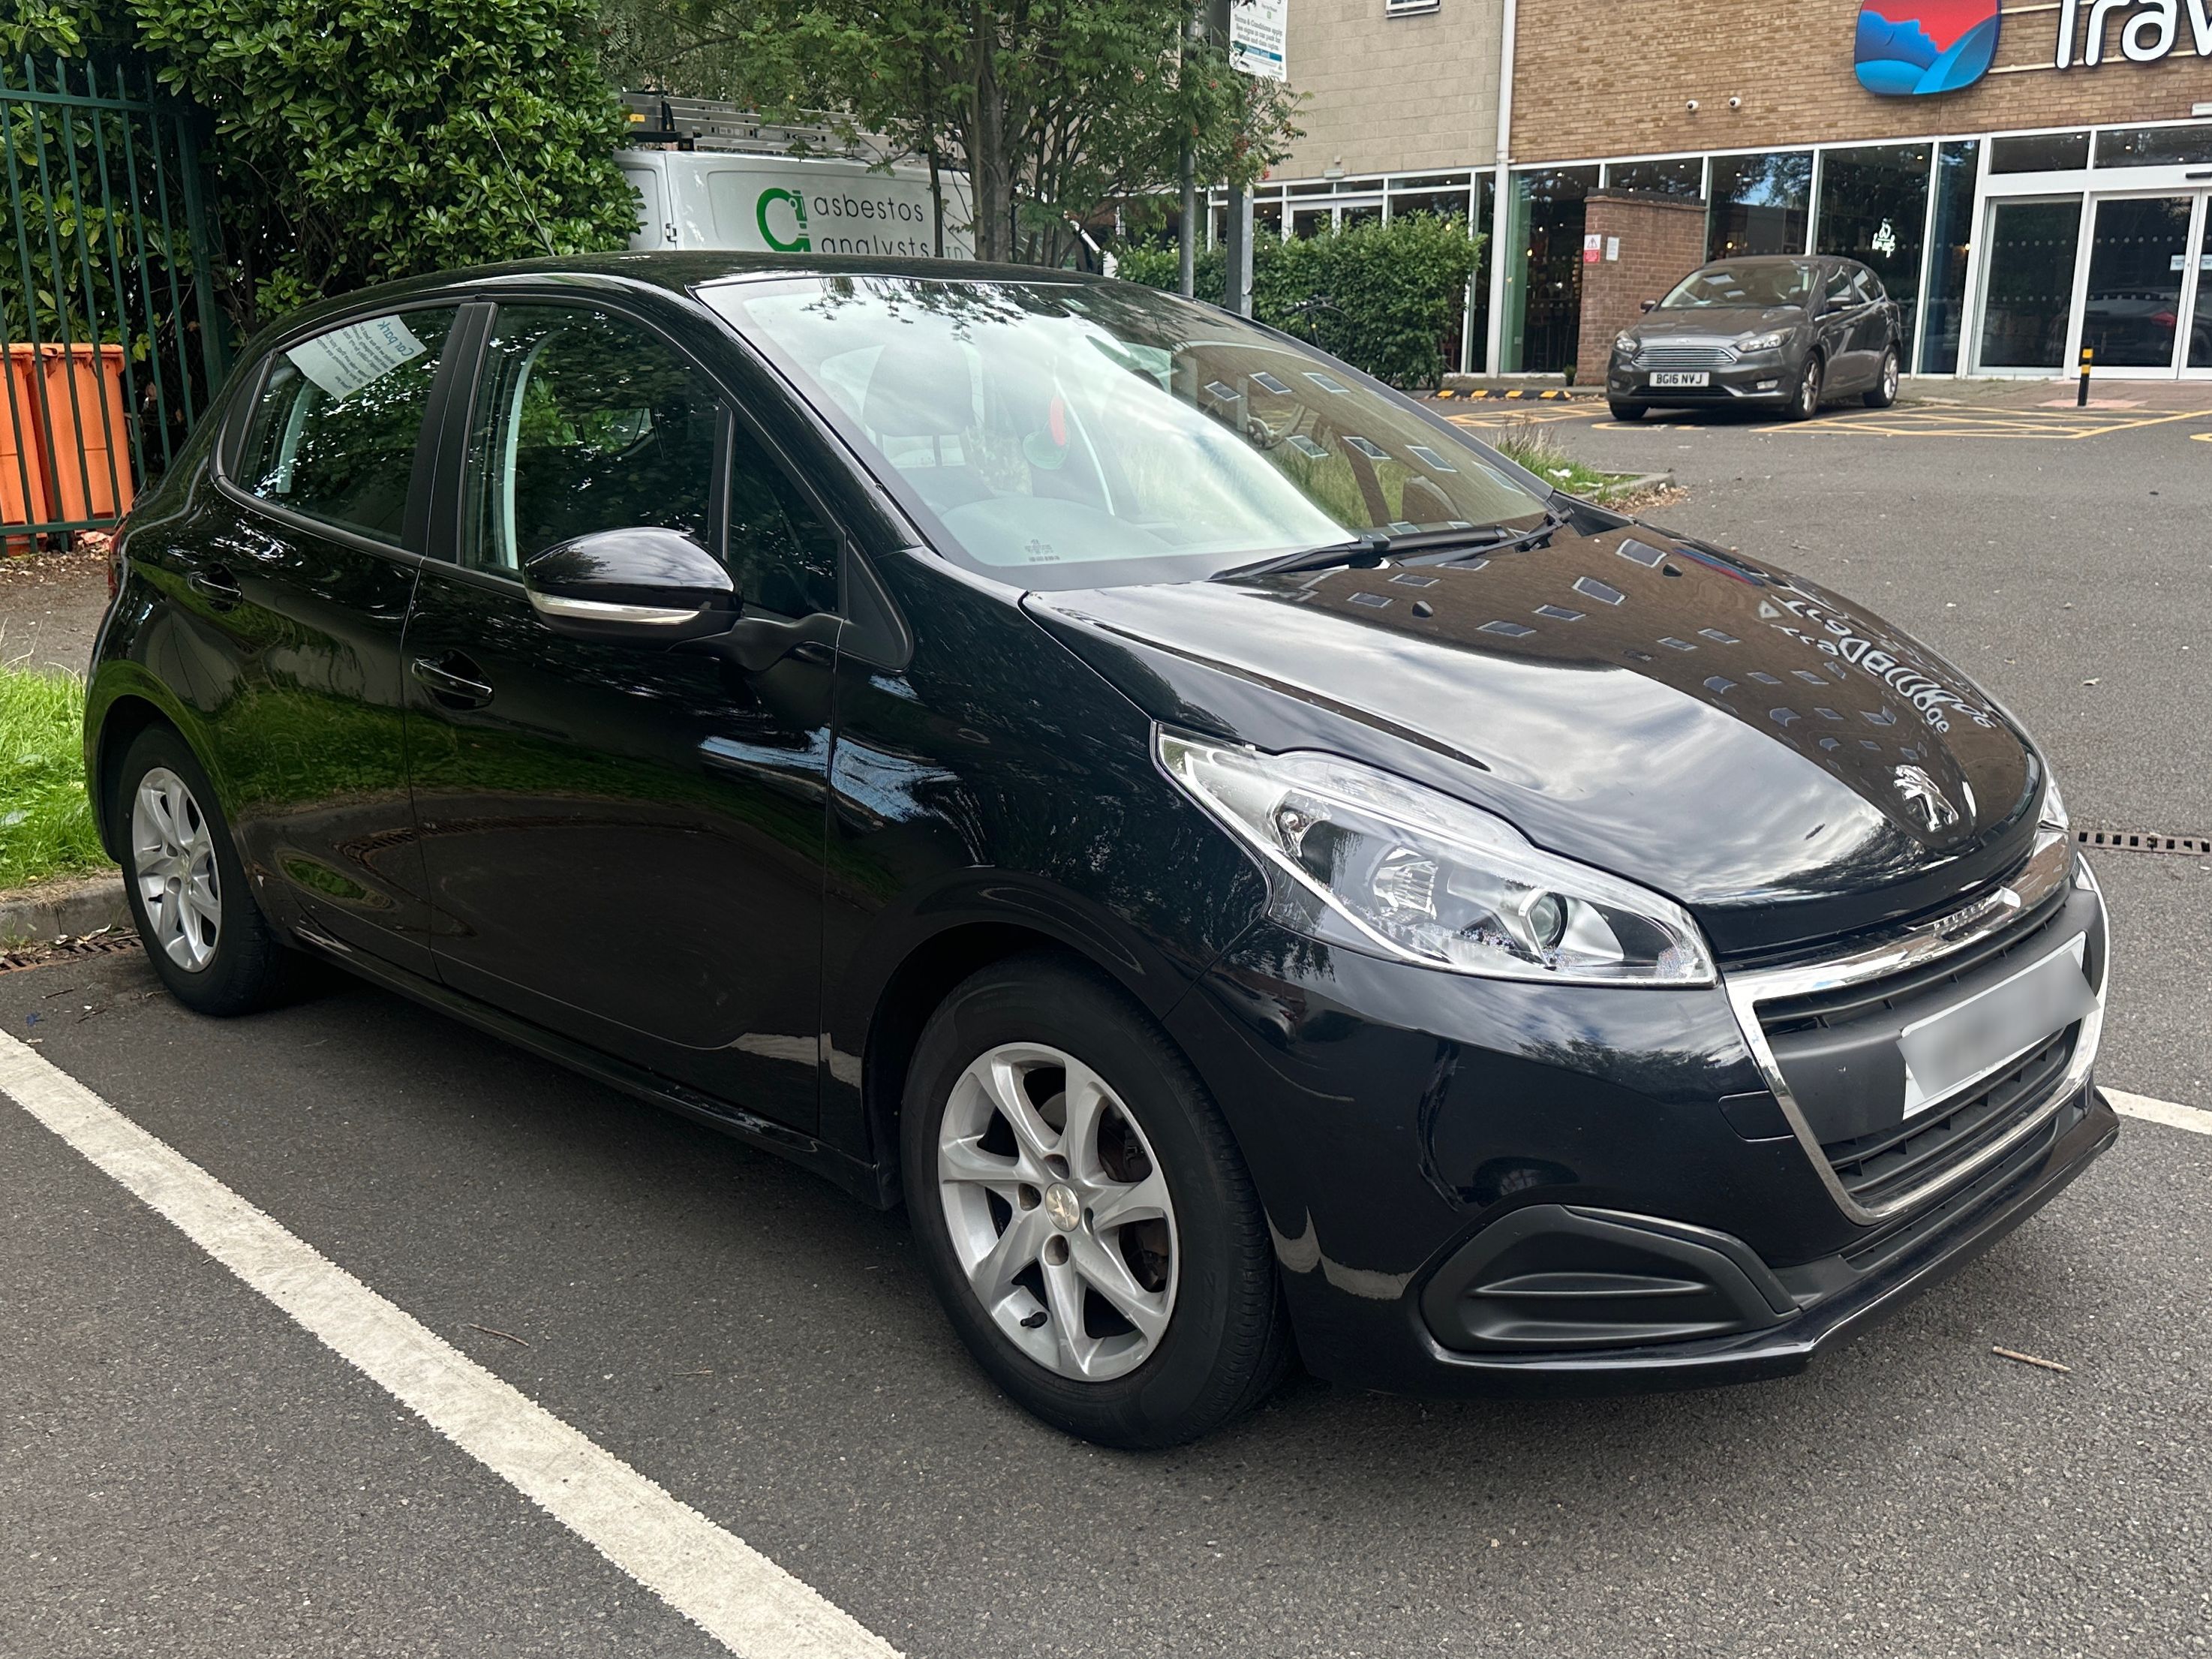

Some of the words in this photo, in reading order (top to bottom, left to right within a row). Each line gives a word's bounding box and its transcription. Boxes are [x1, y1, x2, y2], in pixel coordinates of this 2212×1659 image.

[813, 194, 924, 222] asbestos
[822, 235, 929, 257] analysts
[1657, 374, 1679, 384] BG16
[1682, 374, 1703, 384] NVJ
